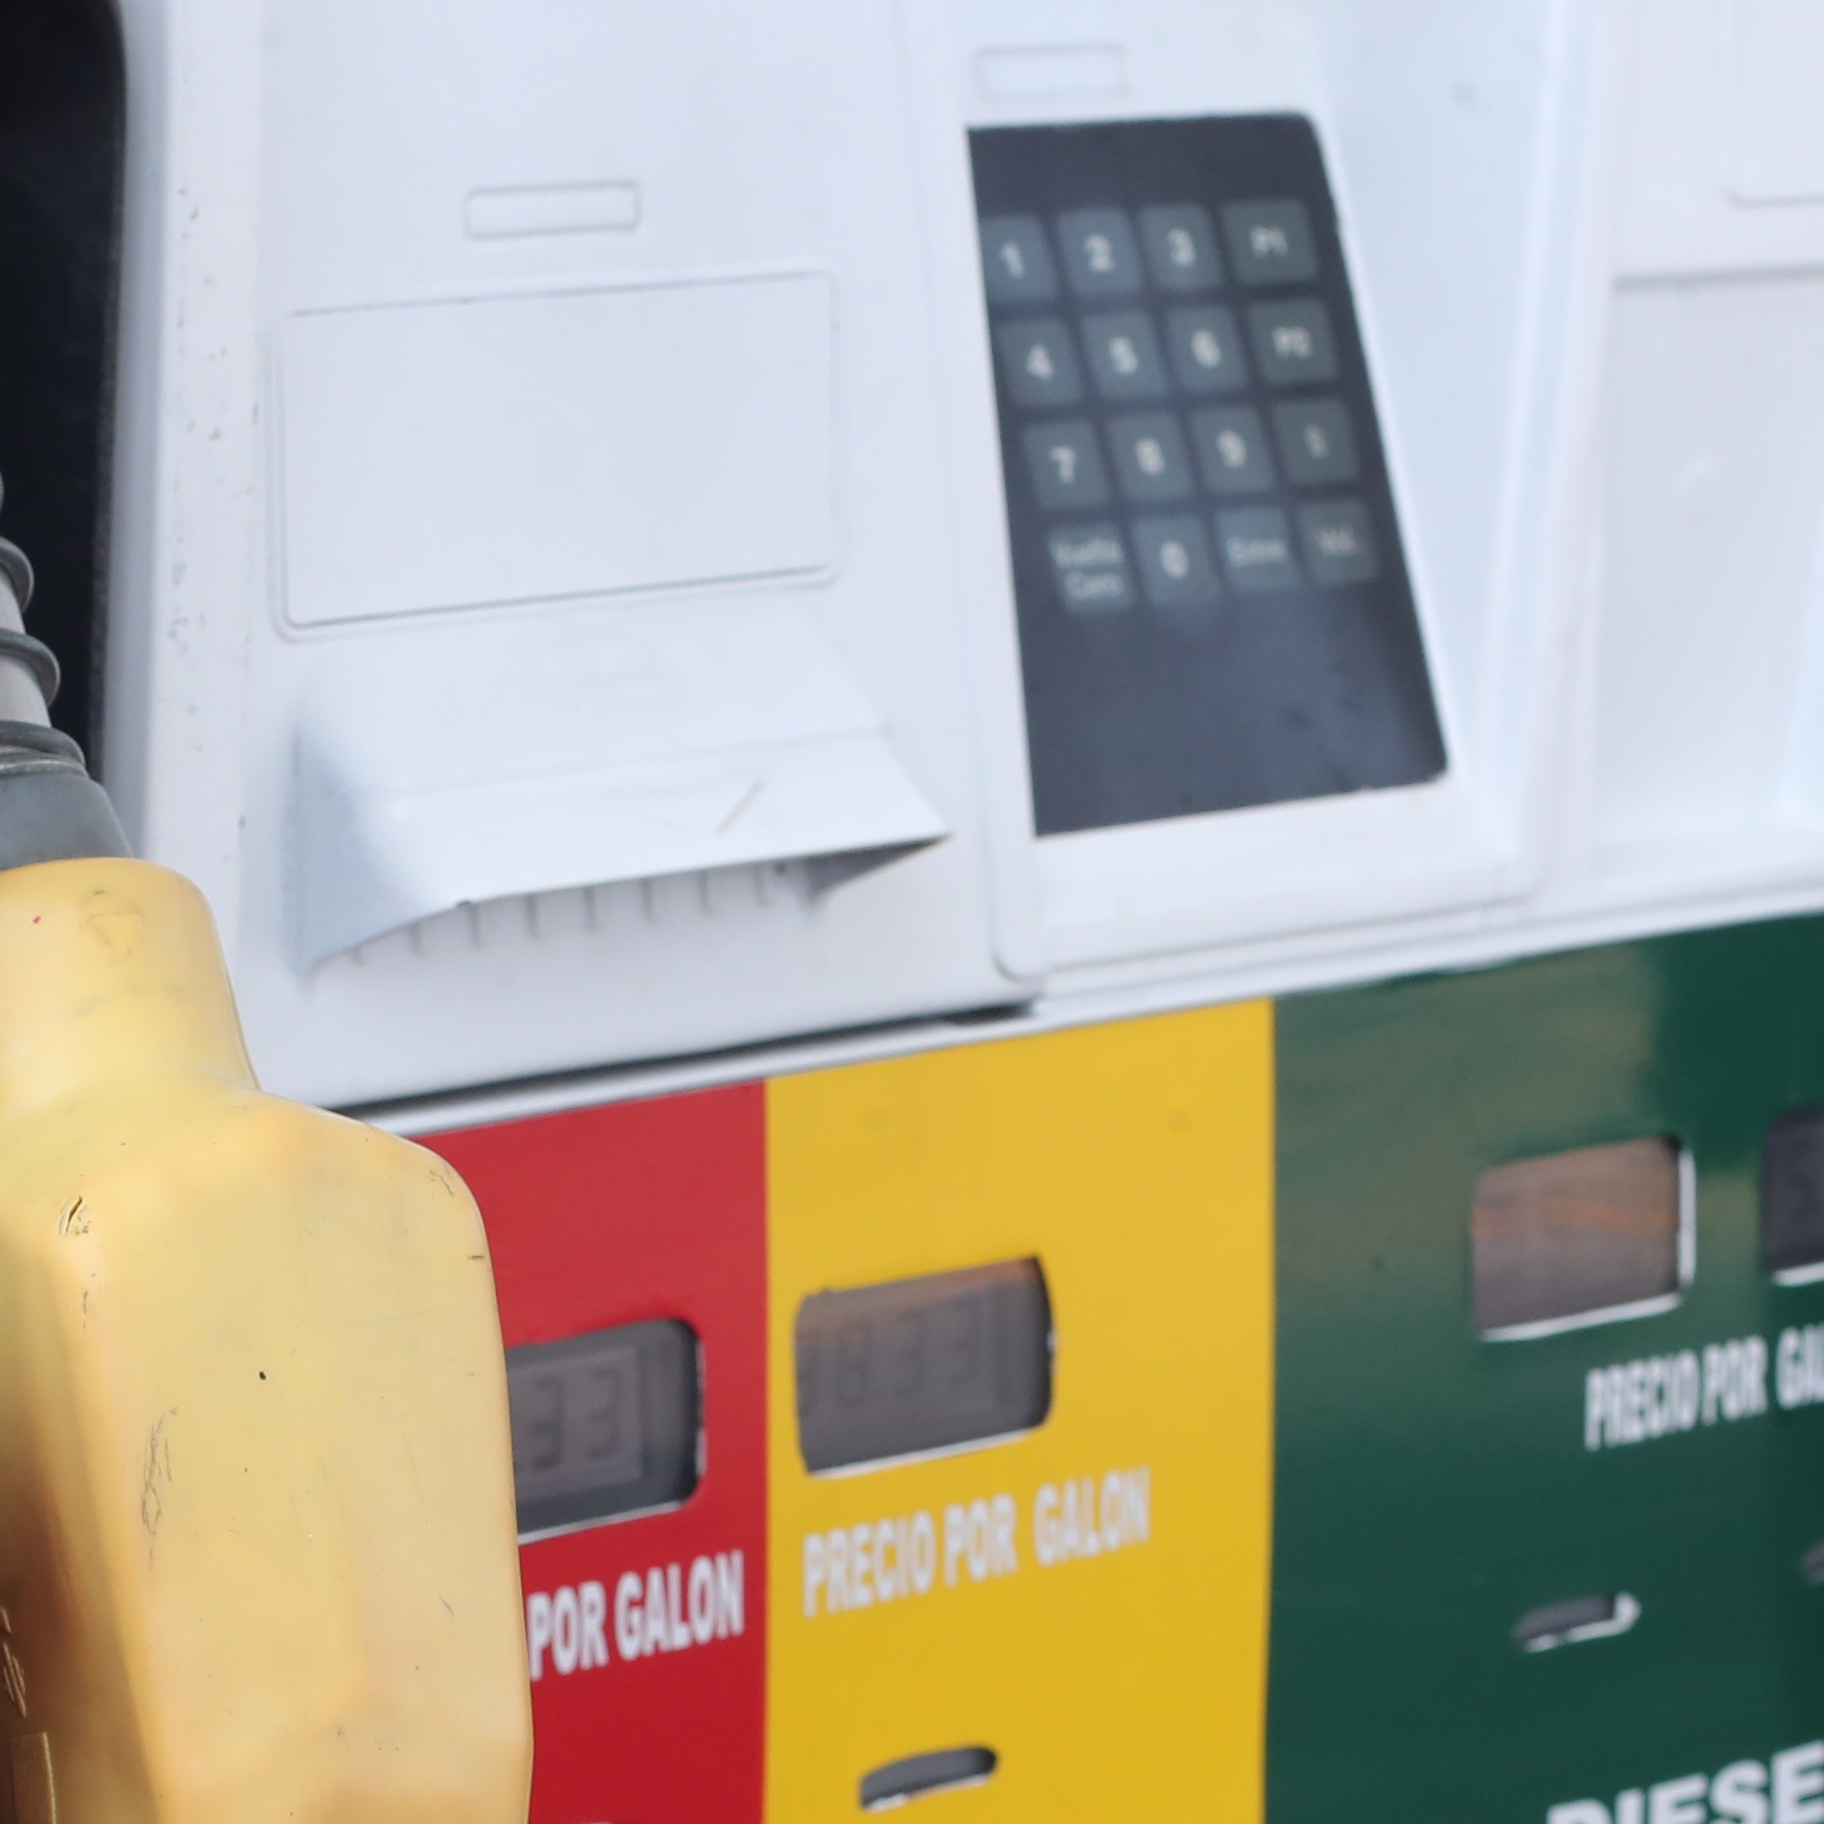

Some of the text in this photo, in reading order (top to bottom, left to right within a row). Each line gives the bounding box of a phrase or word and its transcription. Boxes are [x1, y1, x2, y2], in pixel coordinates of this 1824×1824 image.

[1000, 240, 1024, 279] 1
[1084, 231, 1116, 273] 2
[1168, 227, 1198, 268] 3
[1025, 342, 1054, 380] 4
[1108, 335, 1140, 376] 5
[1190, 328, 1222, 369] 6
[1048, 445, 1075, 483] 7
[1160, 540, 1190, 579] 0
[1586, 1349, 1699, 1450] PRECIO
[1702, 1335, 1768, 1426] POR
[803, 1466, 1152, 1618] PRECIO POR GALON
[528, 1550, 744, 1682] POR GALON
